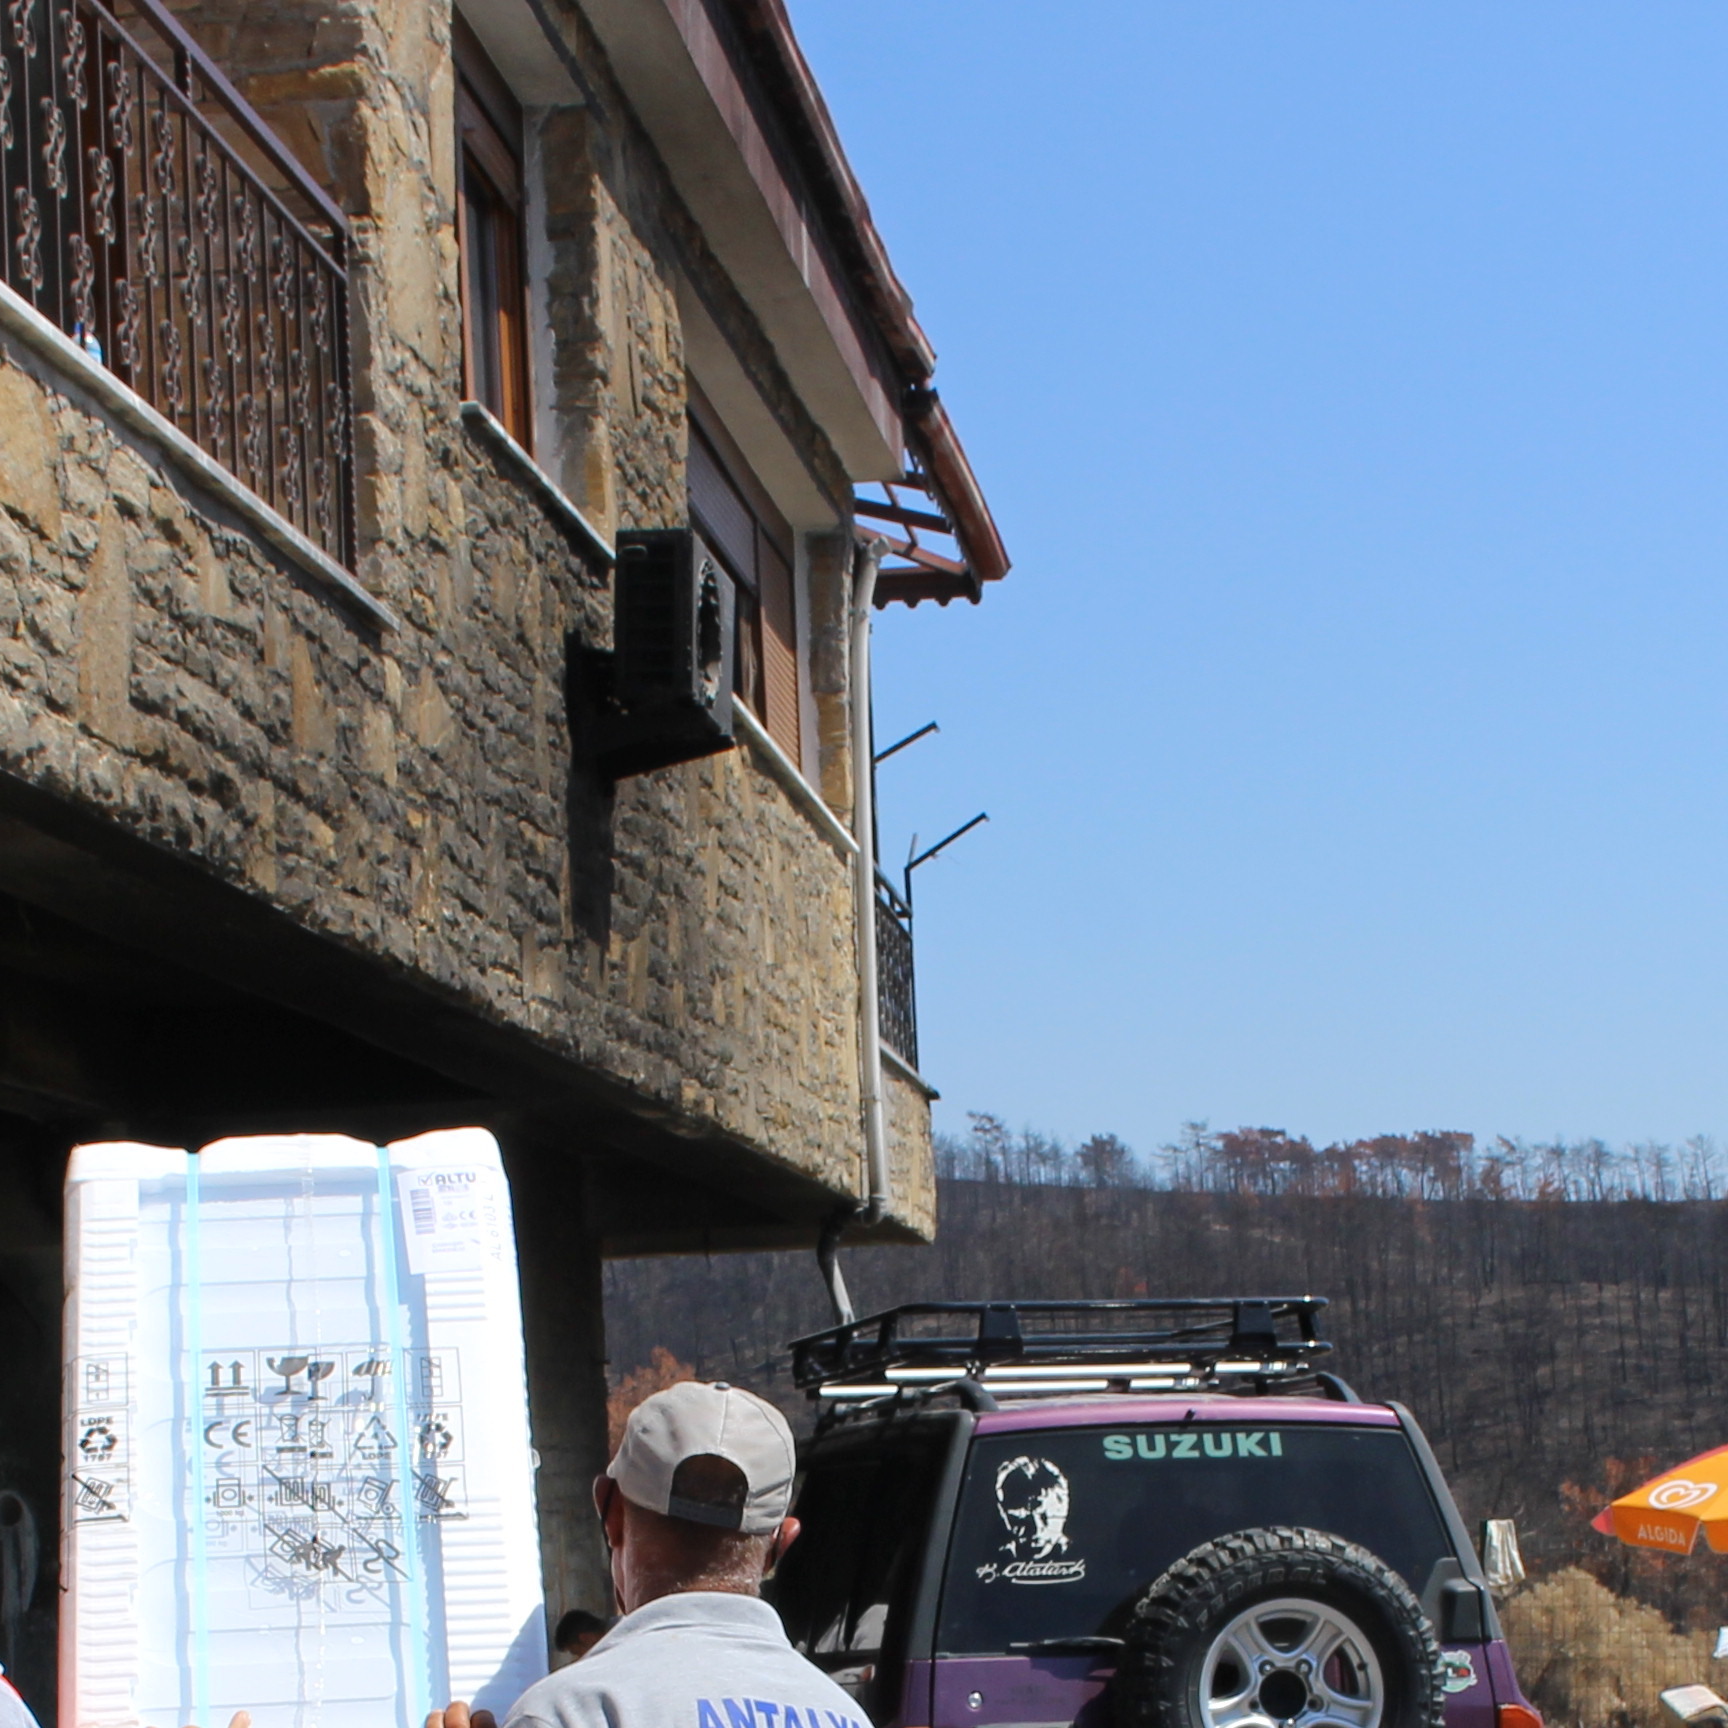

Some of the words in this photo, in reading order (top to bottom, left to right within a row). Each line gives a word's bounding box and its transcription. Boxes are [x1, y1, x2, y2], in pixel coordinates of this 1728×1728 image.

[435, 1172, 476, 1185] ALTU
[80, 1416, 113, 1426] LDPE
[1103, 1432, 1282, 1460] SUZUKI
[1637, 1524, 1686, 1546] ALGIDA
